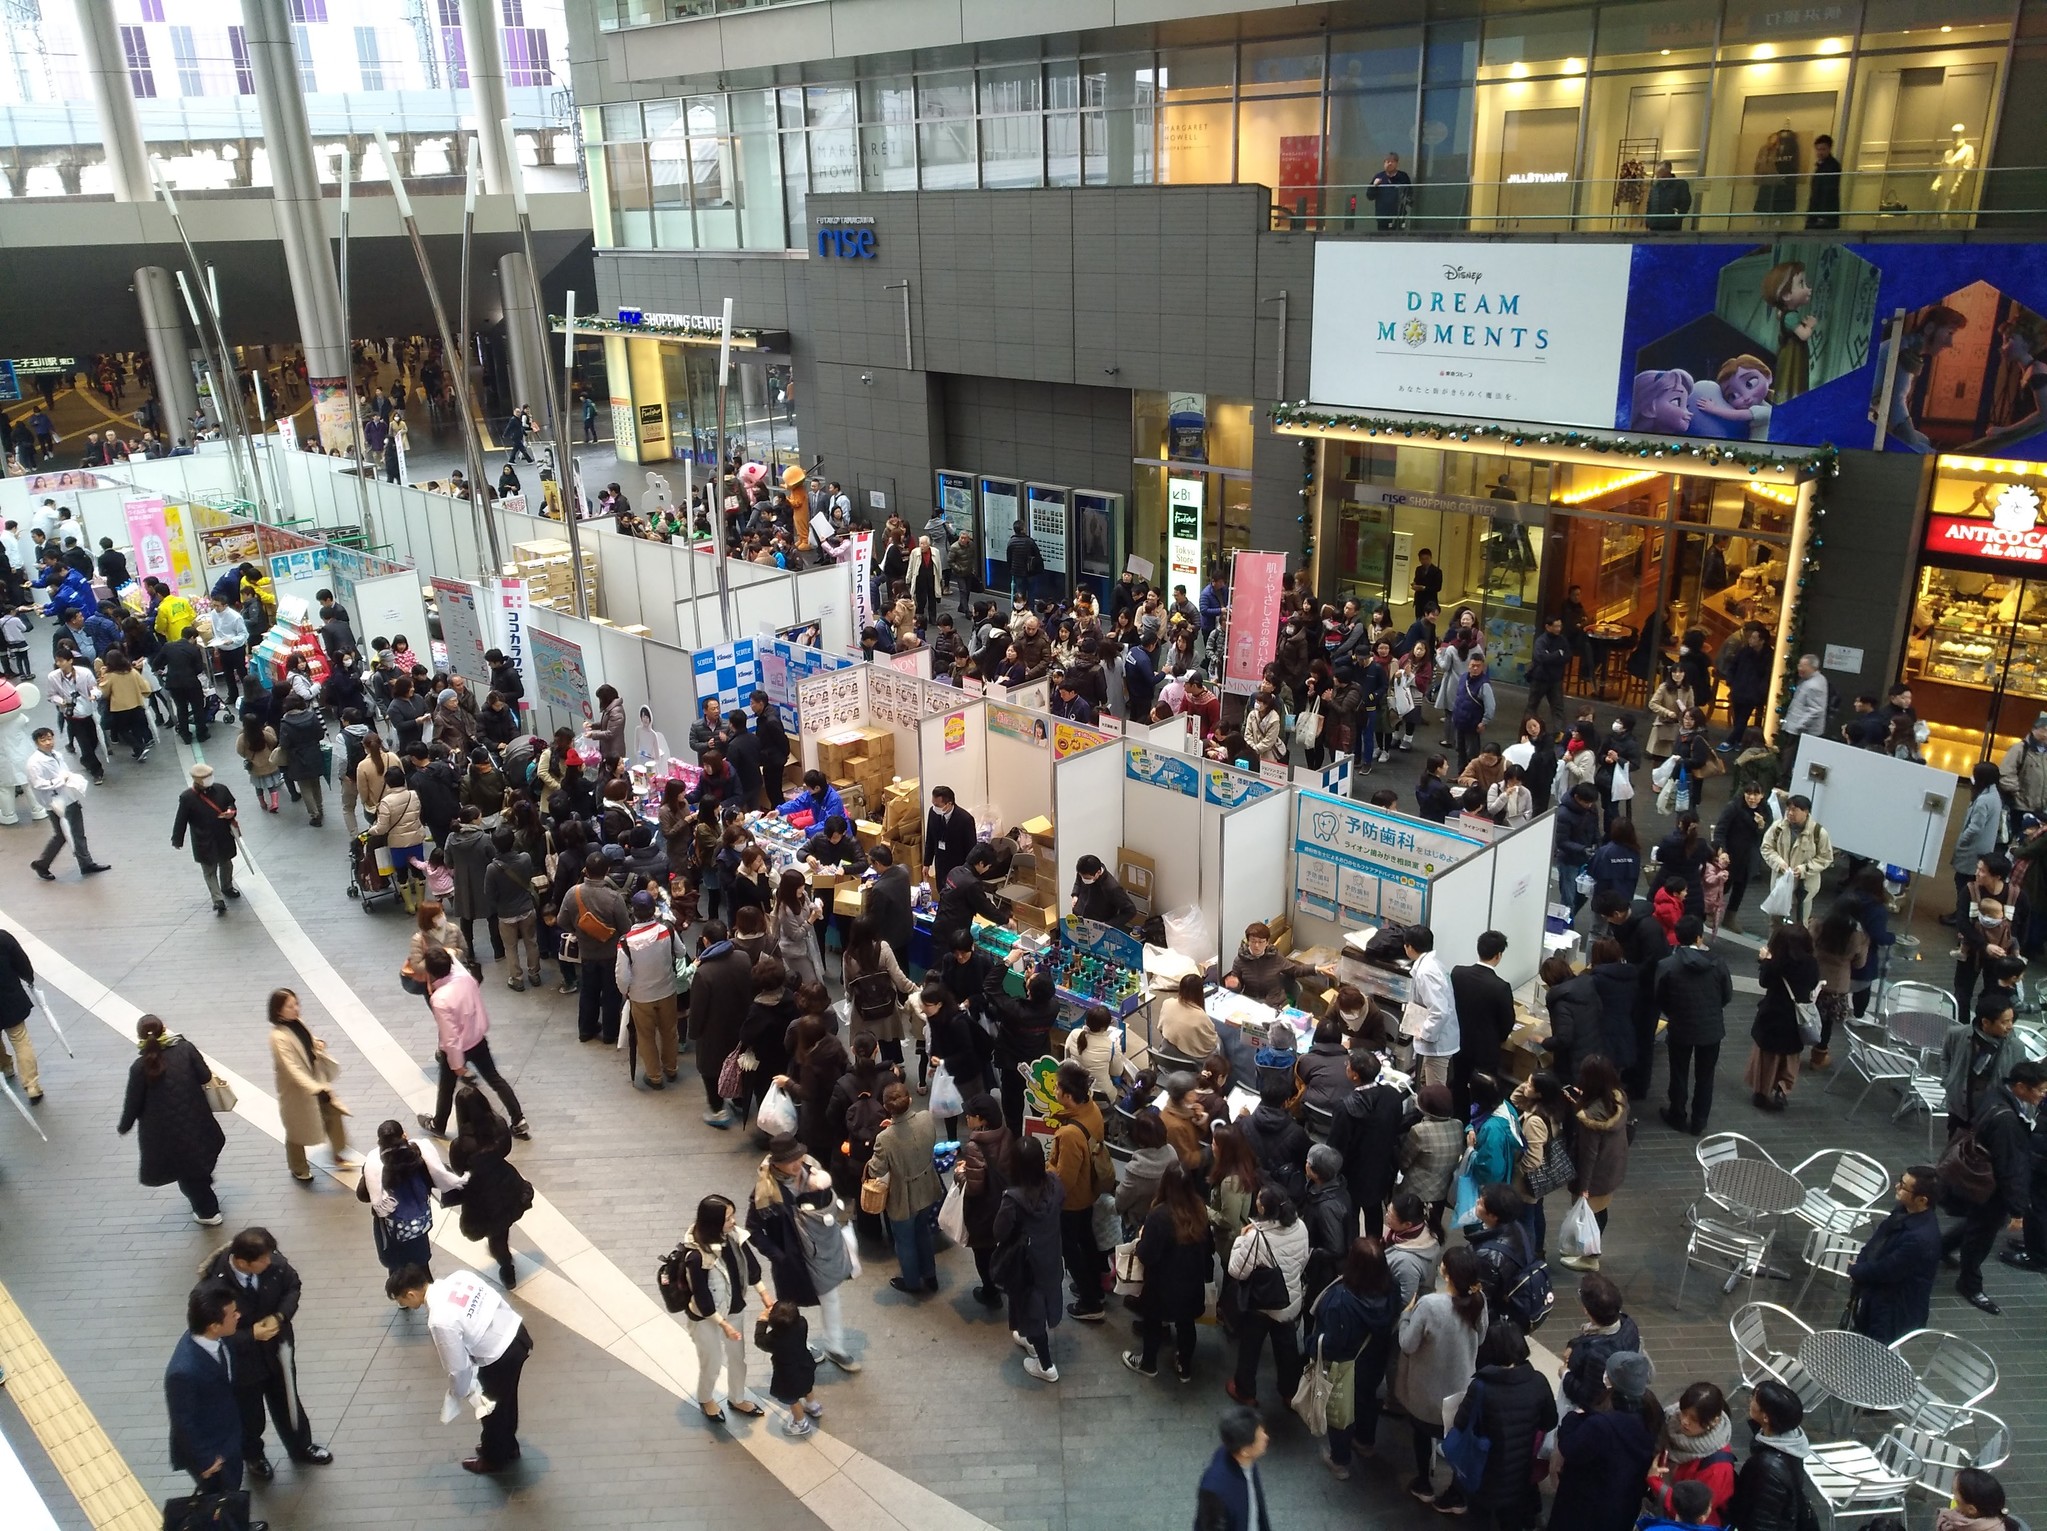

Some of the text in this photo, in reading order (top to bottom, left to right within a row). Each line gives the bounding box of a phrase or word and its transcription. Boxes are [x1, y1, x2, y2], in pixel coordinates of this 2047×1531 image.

[1164, 134, 1198, 142] HOWELL
[818, 141, 897, 157] MARGARET
[817, 228, 877, 259] rise
[1442, 264, 1483, 285] Disney
[1406, 290, 1521, 316] DREAM
[643, 312, 691, 328] SHOPPING
[691, 315, 724, 331] CENTE
[12, 357, 58, 368] 二子玉川駅
[1382, 493, 1498, 517] rise SHOPPING CENTER
[1944, 524, 2024, 546] ANTICO
[1175, 545, 1196, 556] Tokyu
[1176, 554, 1194, 564] Store
[1981, 543, 2003, 556] AL
[1227, 680, 1260, 694] MINO
[1345, 815, 1416, 853] 予防歯科
[1343, 840, 1420, 871] ライオン歯みがき相談室
